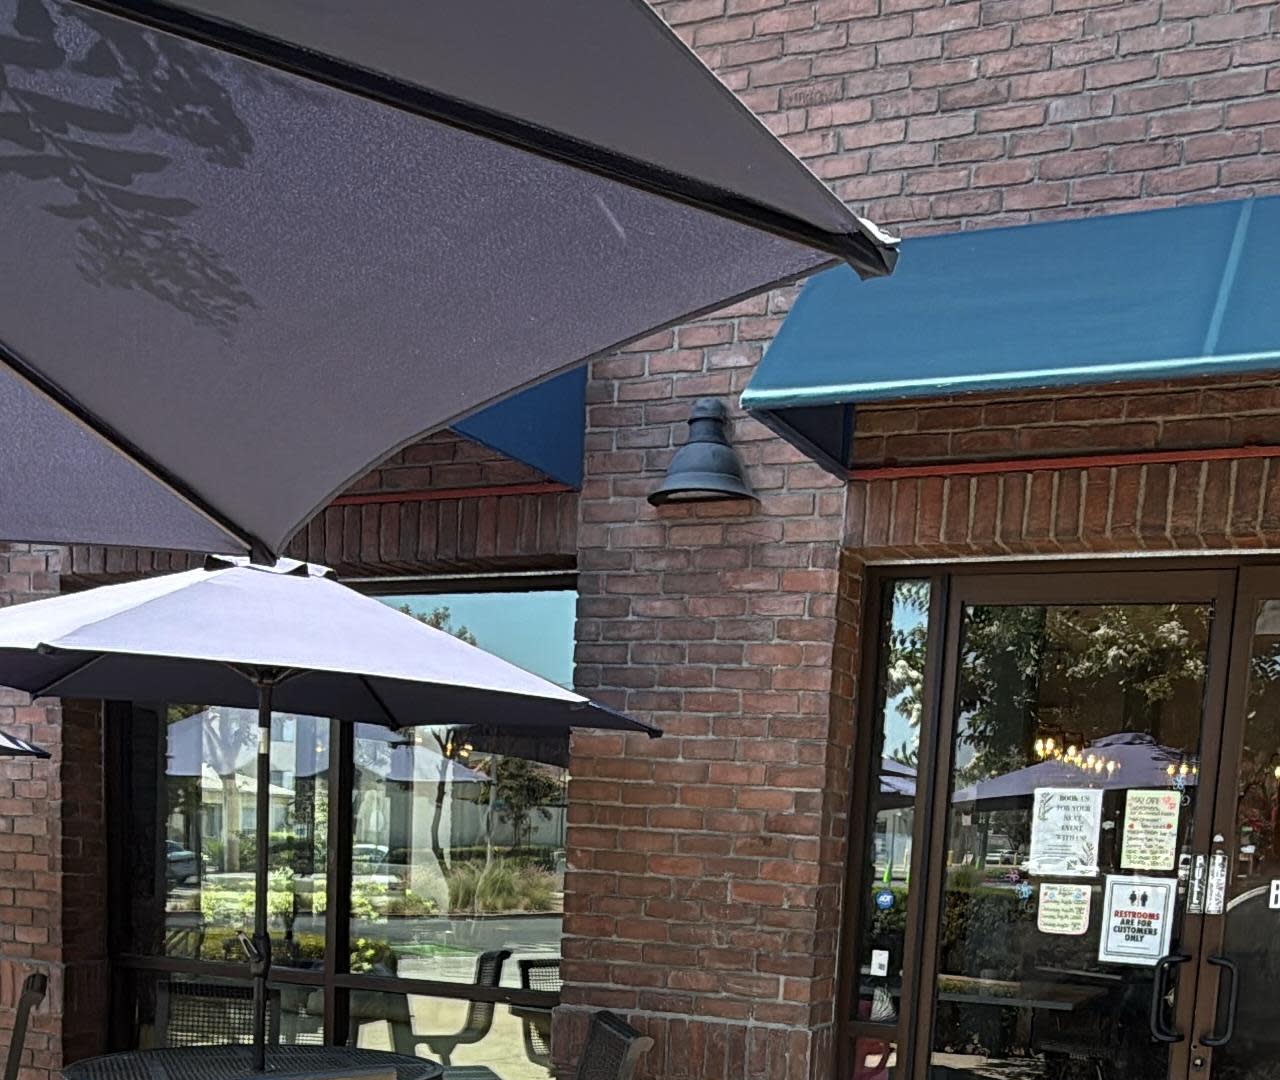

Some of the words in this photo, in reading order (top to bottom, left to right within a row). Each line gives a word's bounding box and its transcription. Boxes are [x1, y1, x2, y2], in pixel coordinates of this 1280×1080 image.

[1114, 910, 1160, 920] RESTROOMS
[1120, 918, 1135, 926] ARE
[1137, 919, 1152, 927] FOR
[1113, 925, 1158, 936] CUSTOMERS
[1124, 934, 1145, 942] ONLY
